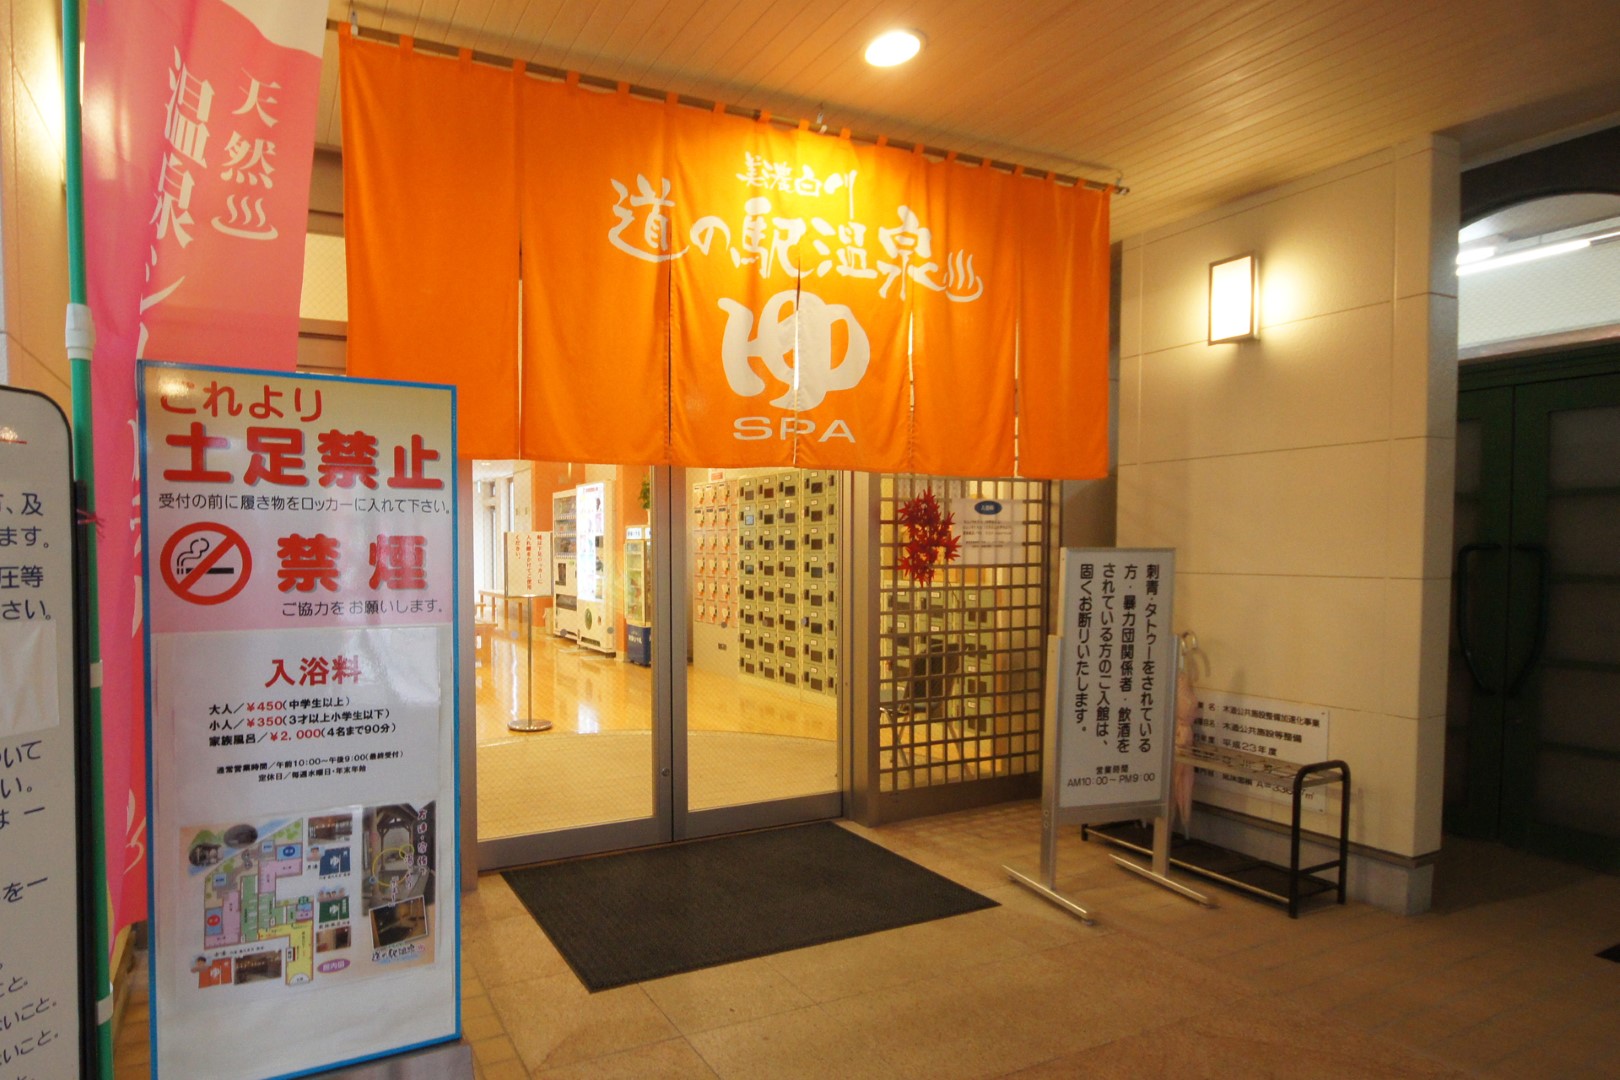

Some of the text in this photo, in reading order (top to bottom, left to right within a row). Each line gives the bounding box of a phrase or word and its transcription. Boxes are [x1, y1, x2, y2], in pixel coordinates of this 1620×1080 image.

[220, 67, 282, 189] 天然
[737, 151, 858, 220] 美濃白川
[607, 173, 946, 301] 道の駅温泉
[717, 289, 871, 412] ゆ
[160, 380, 323, 423] これより
[732, 416, 857, 443] SPA
[162, 421, 444, 490] 土足禁止
[0, 492, 43, 516] 、及
[158, 493, 450, 515] 受付の前に履き物をロッカーに入れて下さい。
[276, 532, 428, 593] 禁煙
[1, 599, 51, 621] さい。
[264, 654, 363, 688] 入浴料
[0, 740, 42, 768] いて
[1096, 764, 1129, 775] 営業時間
[1, 777, 33, 799] い。
[0, 997, 57, 1031] いこと。
[0, 1030, 59, 1066] いこと。
